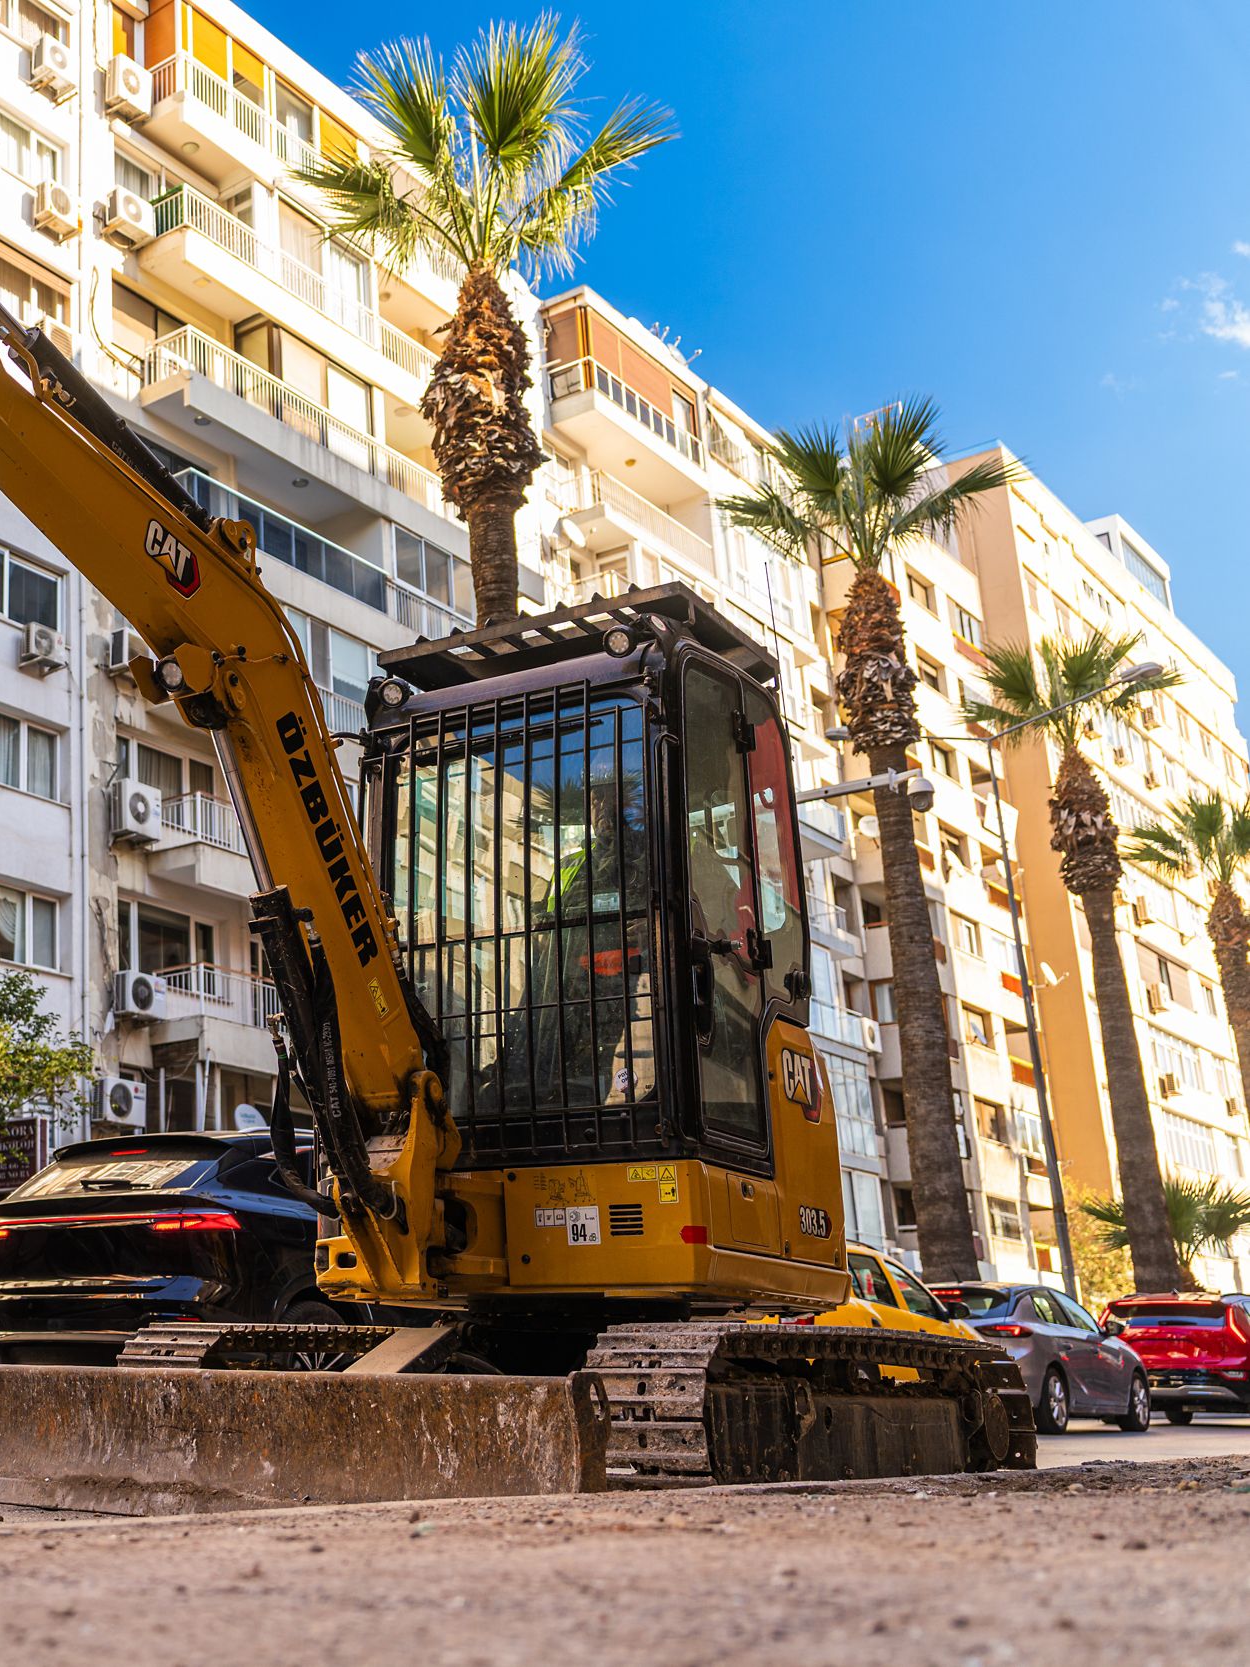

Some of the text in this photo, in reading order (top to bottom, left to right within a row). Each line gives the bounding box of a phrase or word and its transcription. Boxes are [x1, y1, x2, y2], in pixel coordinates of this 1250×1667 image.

[145, 519, 192, 582] CAT
[276, 711, 379, 968] ÖZBÜKER
[782, 1049, 813, 1106] CAT
[329, 1097, 342, 1118] CAT
[571, 1223, 587, 1242] 94
[800, 1206, 827, 1238] 303.5
